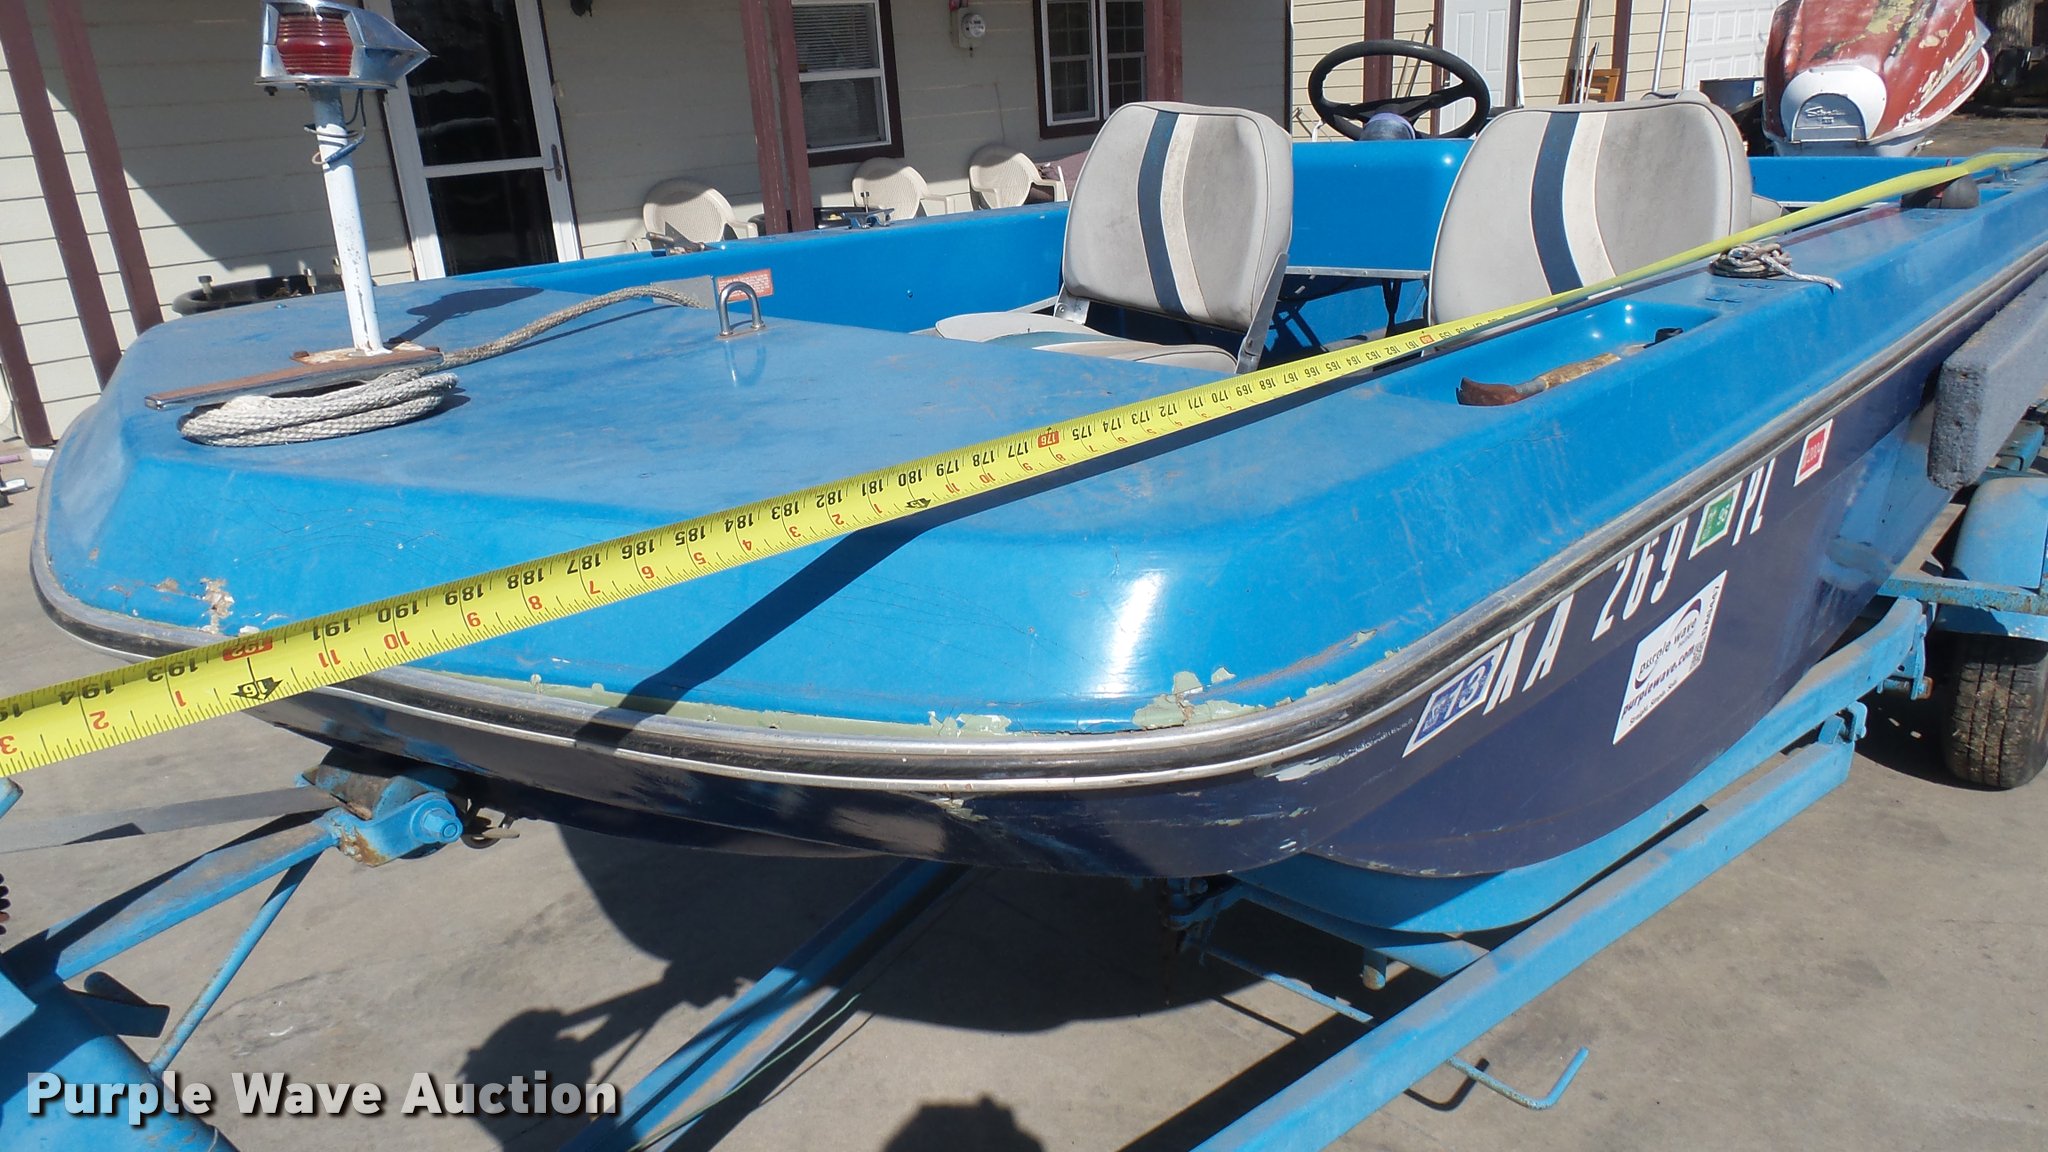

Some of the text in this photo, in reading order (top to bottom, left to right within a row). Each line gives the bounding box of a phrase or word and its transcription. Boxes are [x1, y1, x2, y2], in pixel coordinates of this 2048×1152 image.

[1384, 345, 1400, 356] 162
[1405, 340, 1420, 350] 161
[1346, 355, 1362, 367] 164
[1365, 350, 1381, 361] 163
[1304, 366, 1321, 379] 166
[1325, 360, 1342, 373] 165
[1259, 377, 1277, 391] 168
[1283, 371, 1299, 385] 167
[1211, 389, 1229, 404] 170
[1235, 383, 1254, 397] 169
[1158, 403, 1178, 418] 172
[1188, 395, 1204, 410] 171
[1102, 417, 1122, 433] 174
[1131, 409, 1151, 425] 173
[1041, 434, 1057, 446] 176
[1072, 424, 1093, 441] 175
[972, 450, 996, 467] 178
[1008, 441, 1029, 459] 177
[1055, 452, 1067, 462] 8
[936, 458, 960, 477] 179
[898, 468, 923, 487] 180
[979, 472, 997, 484] 10
[861, 478, 884, 497] 181
[945, 482, 961, 494] 11
[816, 489, 843, 508] 182
[771, 501, 800, 520] 183
[873, 503, 883, 514] 1
[724, 512, 754, 533] 184
[832, 513, 845, 525] 2
[674, 525, 706, 546] 185
[789, 526, 801, 538] 3
[621, 538, 655, 560] 186
[742, 539, 753, 551] 4
[1592, 517, 1688, 641] 269
[1732, 457, 1776, 546] PL
[566, 553, 601, 575] 187
[693, 552, 707, 565] 5
[506, 567, 545, 590] 188
[444, 583, 484, 606] 189
[588, 580, 601, 595] 7
[528, 595, 543, 610] 8
[377, 600, 420, 623] 190
[313, 618, 351, 640] 191
[230, 638, 267, 657] 192
[383, 631, 411, 650] 10
[1639, 640, 1672, 677] purple
[1674, 618, 1698, 645] wave
[318, 649, 341, 668] 11
[147, 658, 199, 682] 193
[242, 682, 268, 698] 16
[1621, 644, 1695, 720] purplewave.com
[58, 679, 115, 705] 194
[175, 690, 187, 707] 1
[1444, 666, 1486, 720] 13
[89, 710, 110, 730] 2
[0, 735, 18, 755] 3
